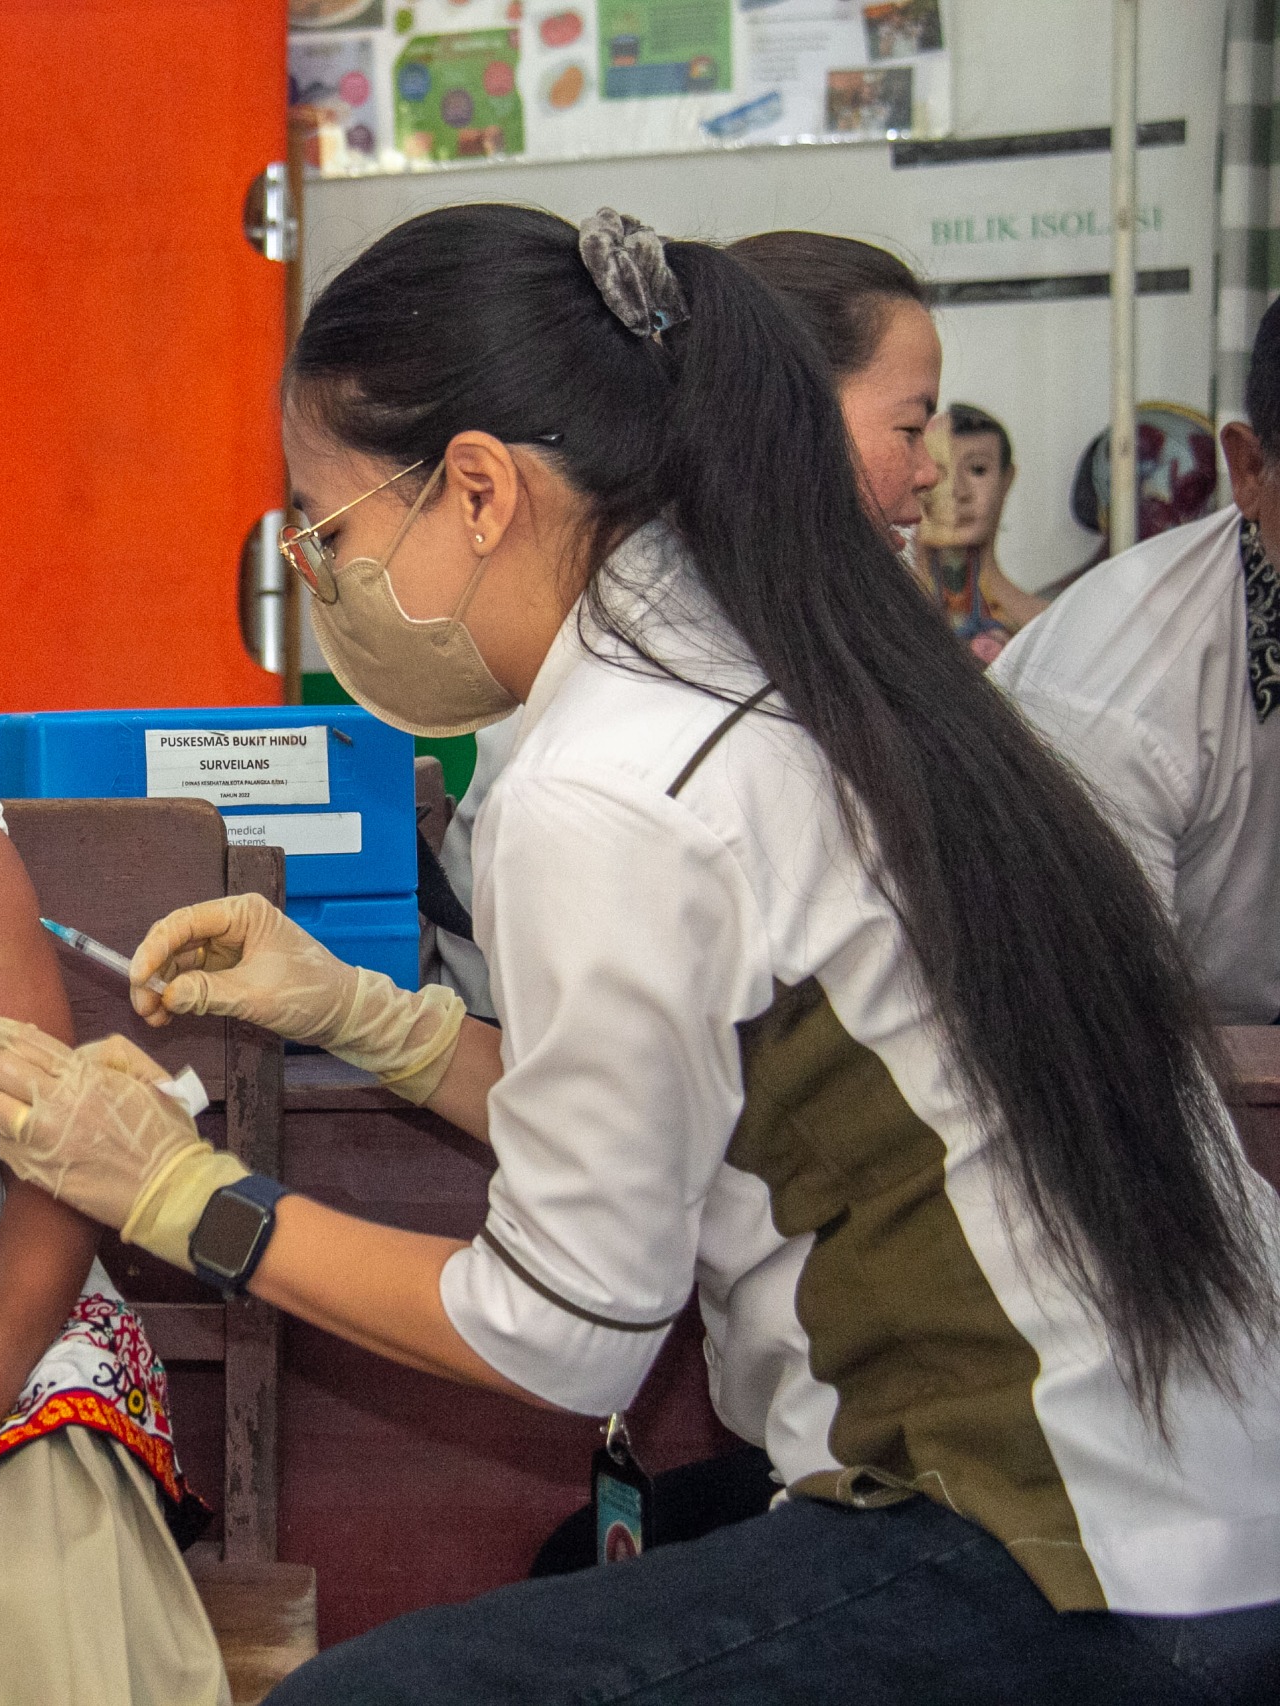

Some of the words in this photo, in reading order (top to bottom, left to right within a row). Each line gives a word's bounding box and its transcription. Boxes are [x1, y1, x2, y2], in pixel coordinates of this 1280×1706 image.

[931, 212, 1019, 246] BILIK
[1031, 205, 1162, 240] ISOLSI
[160, 736, 230, 747] PUSKESMAS
[233, 735, 267, 746] BUKIT
[270, 735, 307, 746] HINDU
[199, 759, 270, 771] SURVEILANS
[227, 825, 266, 835] medical
